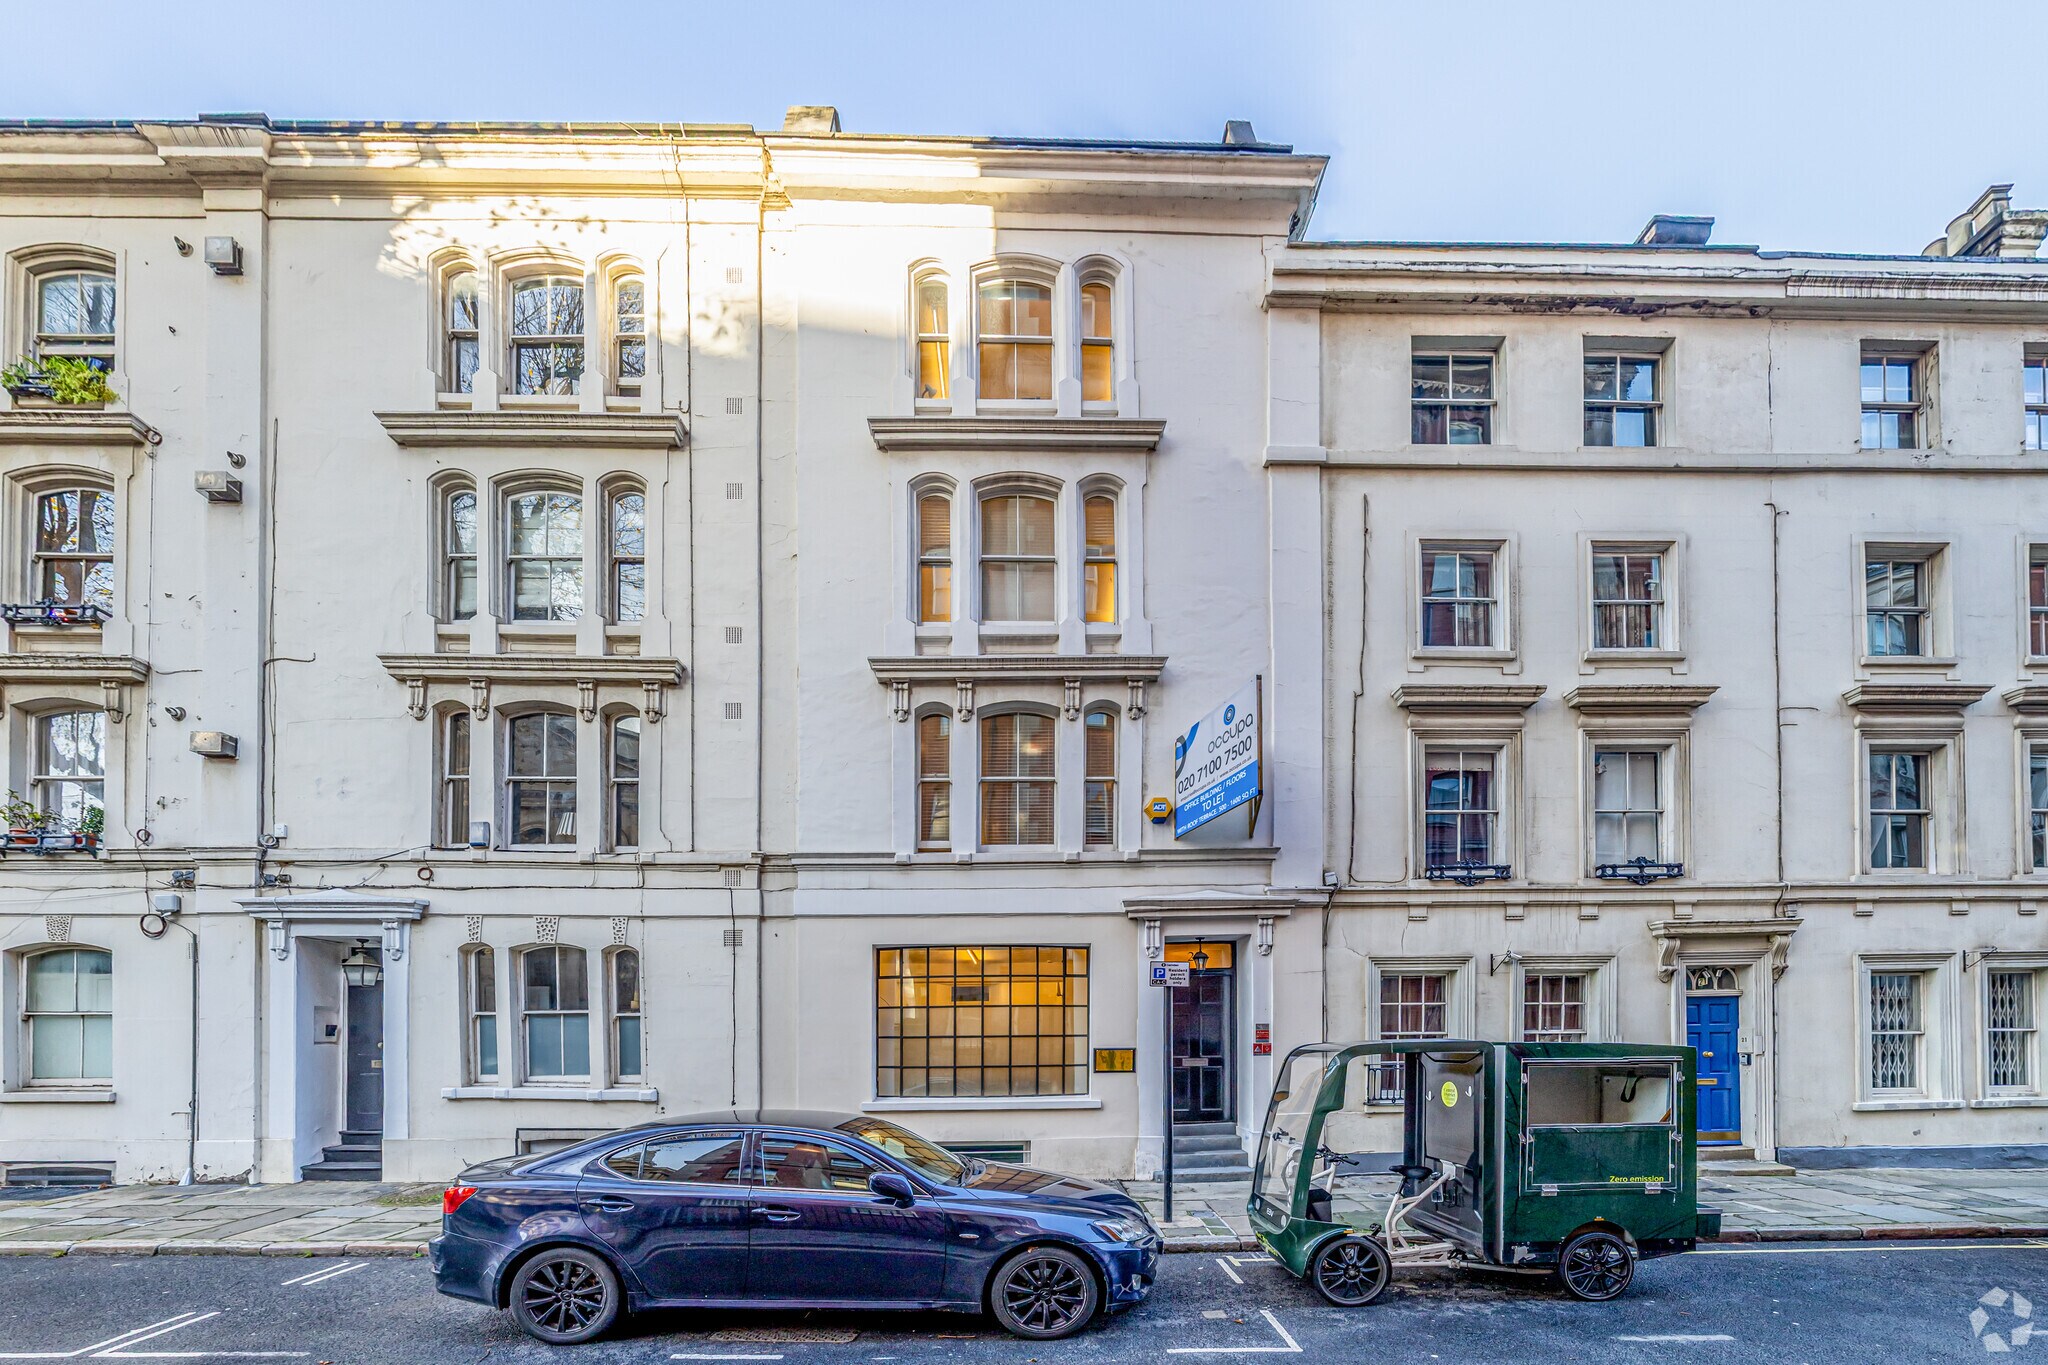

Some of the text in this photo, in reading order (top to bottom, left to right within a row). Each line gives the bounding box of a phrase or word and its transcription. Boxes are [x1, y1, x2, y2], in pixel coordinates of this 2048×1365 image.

[1208, 713, 1254, 753] occupa
[1178, 735, 1252, 794] 020 7100 7500
[1177, 824, 1187, 834] WITH
[1187, 817, 1199, 829] ROOF
[1218, 803, 1227, 813] 500
[1230, 795, 1241, 807] 1600
[1241, 790, 1249, 801] SQ
[1249, 786, 1257, 796] FT
[1183, 797, 1200, 812] OFFICE
[1200, 784, 1222, 803] BUILDING
[1226, 769, 1247, 788] FLOORS
[1202, 791, 1225, 812] TO LET
[1156, 969, 1164, 978] P
